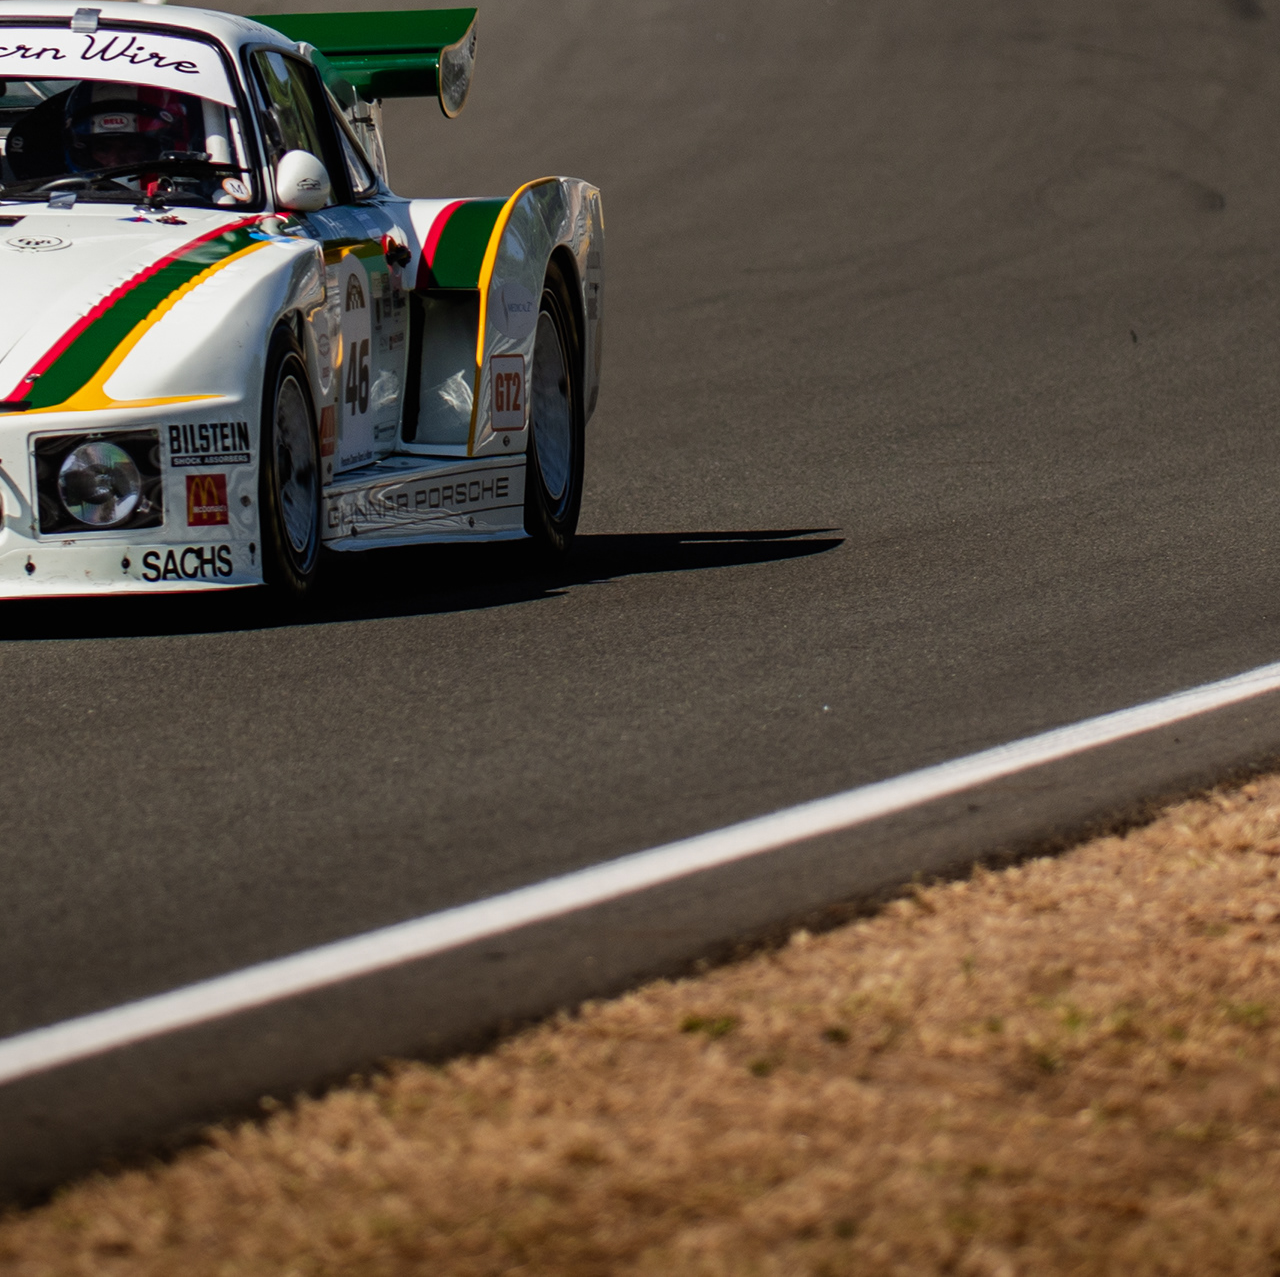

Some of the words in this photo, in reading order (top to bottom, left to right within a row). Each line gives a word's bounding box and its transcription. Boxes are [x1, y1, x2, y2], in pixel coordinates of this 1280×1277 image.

[80, 34, 200, 75] Wire
[345, 338, 370, 417] 46
[495, 372, 521, 413] GT2
[169, 422, 250, 454] BILSTEIN
[174, 457, 203, 466] SHOCK
[204, 454, 249, 465] ABSORBERS
[415, 476, 510, 510] PORSCHE
[142, 544, 234, 583] SACHS
